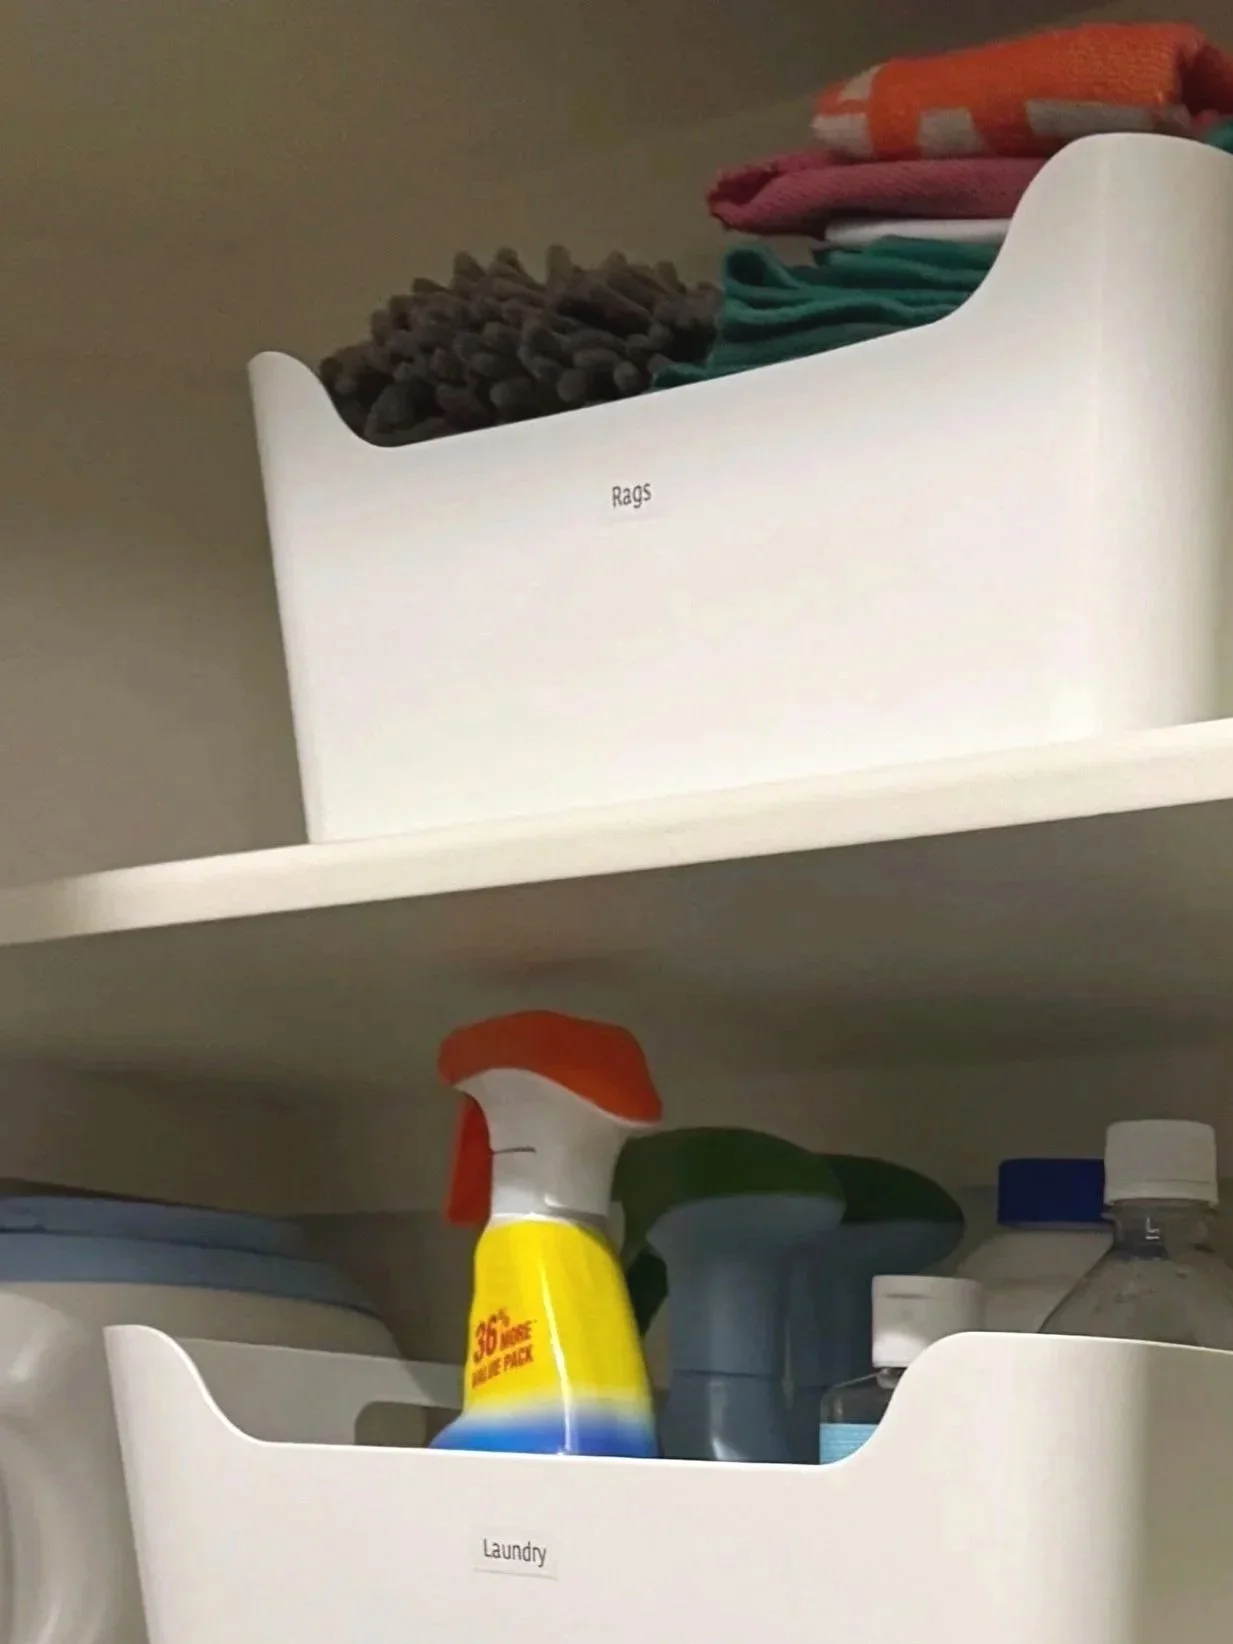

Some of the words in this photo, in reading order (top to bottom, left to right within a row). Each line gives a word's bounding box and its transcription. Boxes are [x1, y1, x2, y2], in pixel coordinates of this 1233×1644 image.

[612, 482, 652, 509] Rags
[500, 1320, 533, 1351] MORE
[472, 1357, 501, 1389] VALUE
[503, 1344, 535, 1371] PACK
[483, 1537, 547, 1568] Laundry
